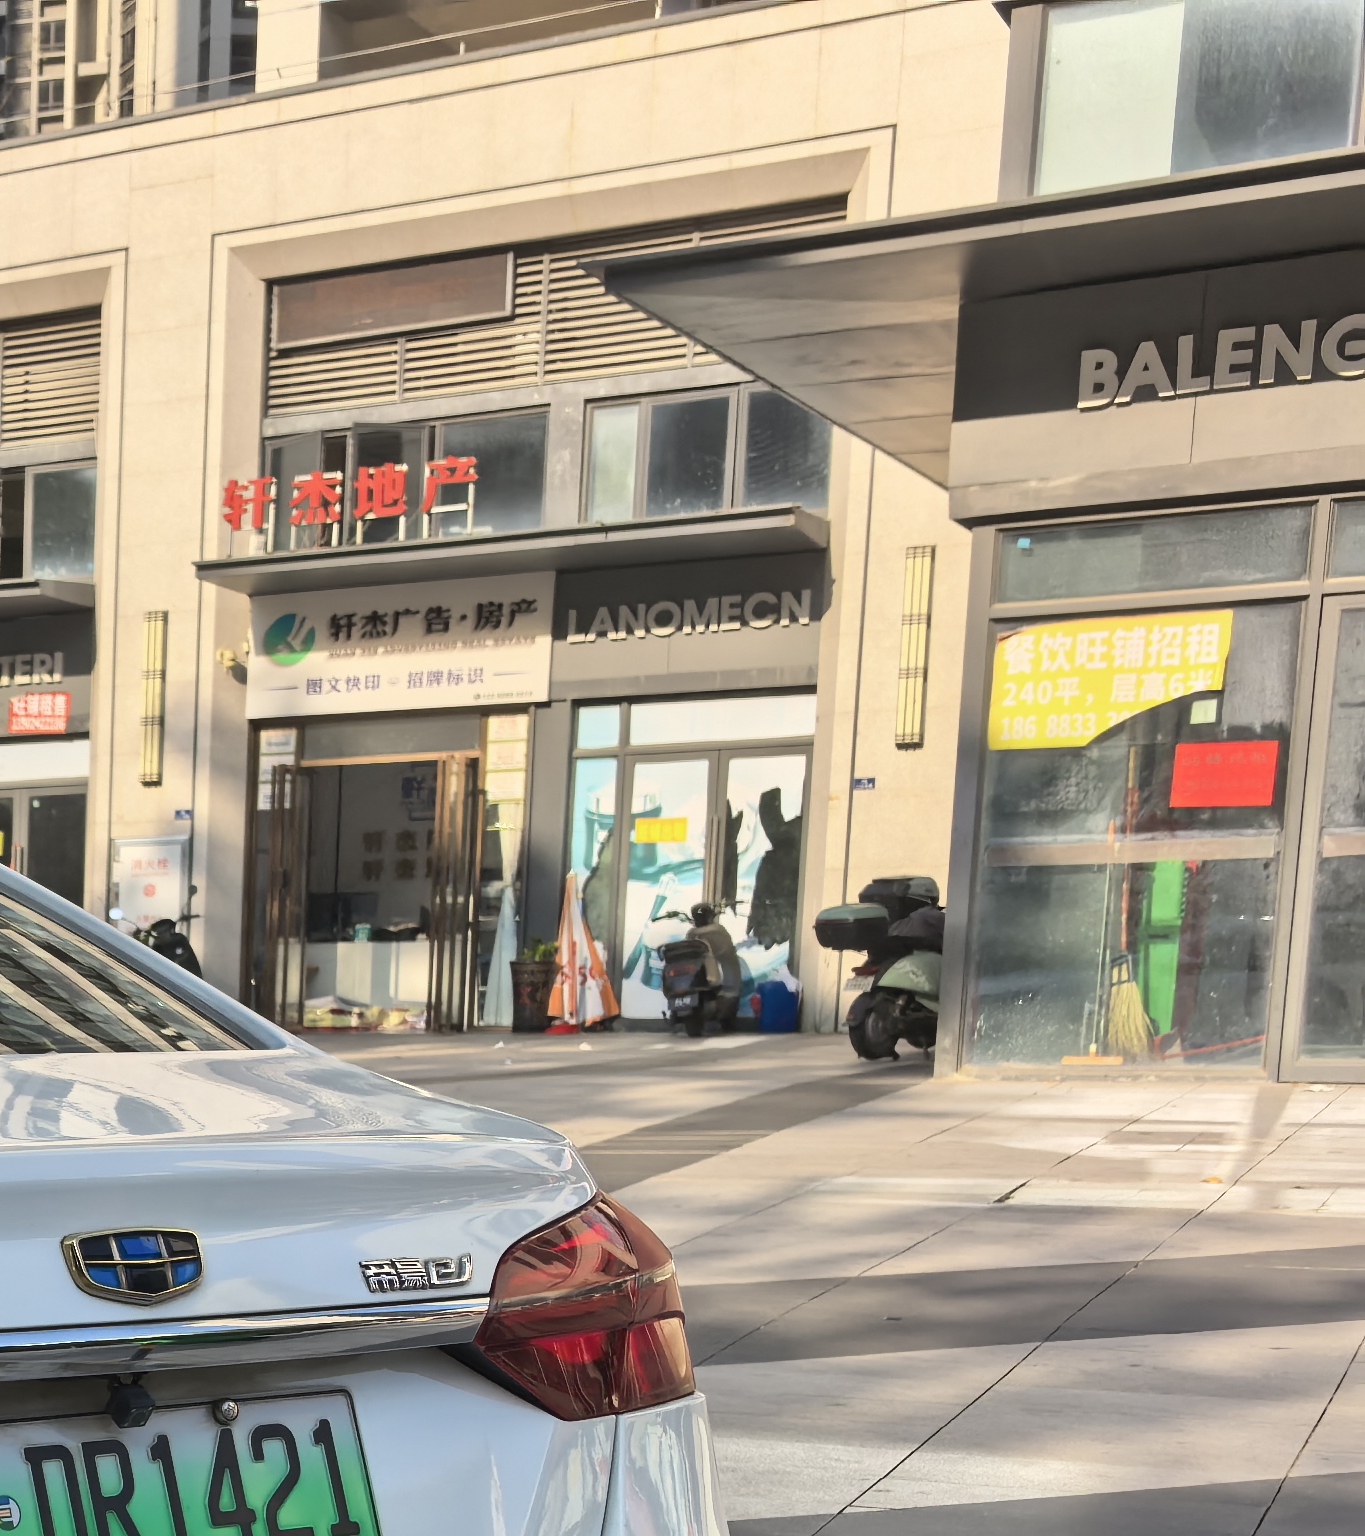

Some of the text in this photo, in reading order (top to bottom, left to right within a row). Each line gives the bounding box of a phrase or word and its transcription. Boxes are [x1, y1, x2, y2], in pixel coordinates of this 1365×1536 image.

[222, 455, 479, 531] 轩杰地产
[567, 589, 812, 644] LANOMECN
[1004, 623, 1221, 675] 餐饮旺铺招租
[306, 673, 381, 696] 图文快印
[1000, 716, 1036, 741] 186
[1047, 711, 1096, 739] 8833
